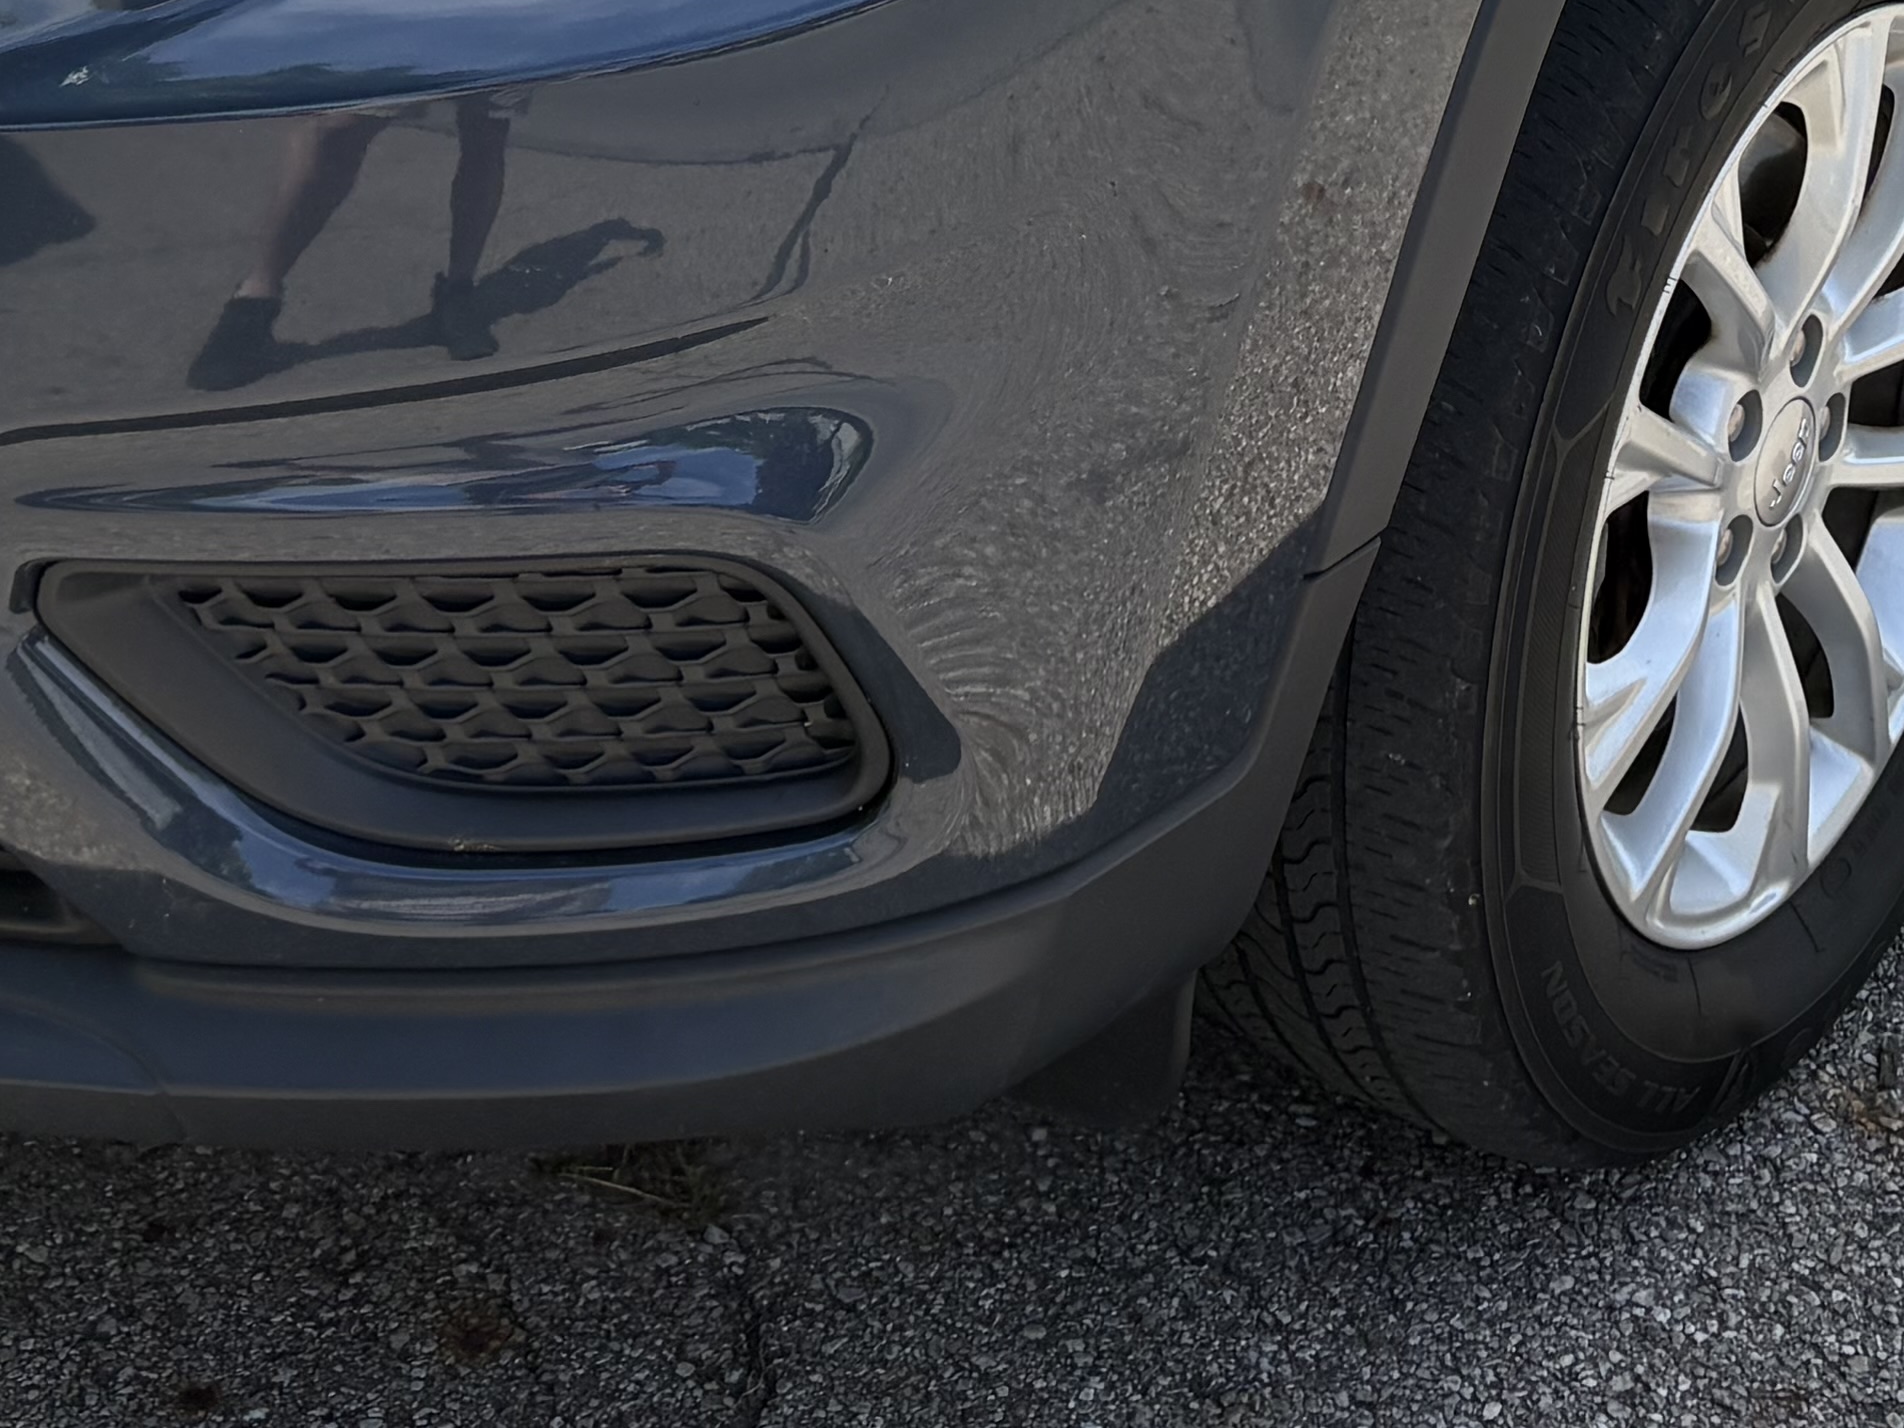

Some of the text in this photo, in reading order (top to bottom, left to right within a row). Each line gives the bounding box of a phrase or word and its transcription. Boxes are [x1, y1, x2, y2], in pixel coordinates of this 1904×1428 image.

[1769, 418, 1810, 509] Jeep
[1540, 960, 1637, 1097] SEASON
[1637, 1079, 1702, 1113] ALL
